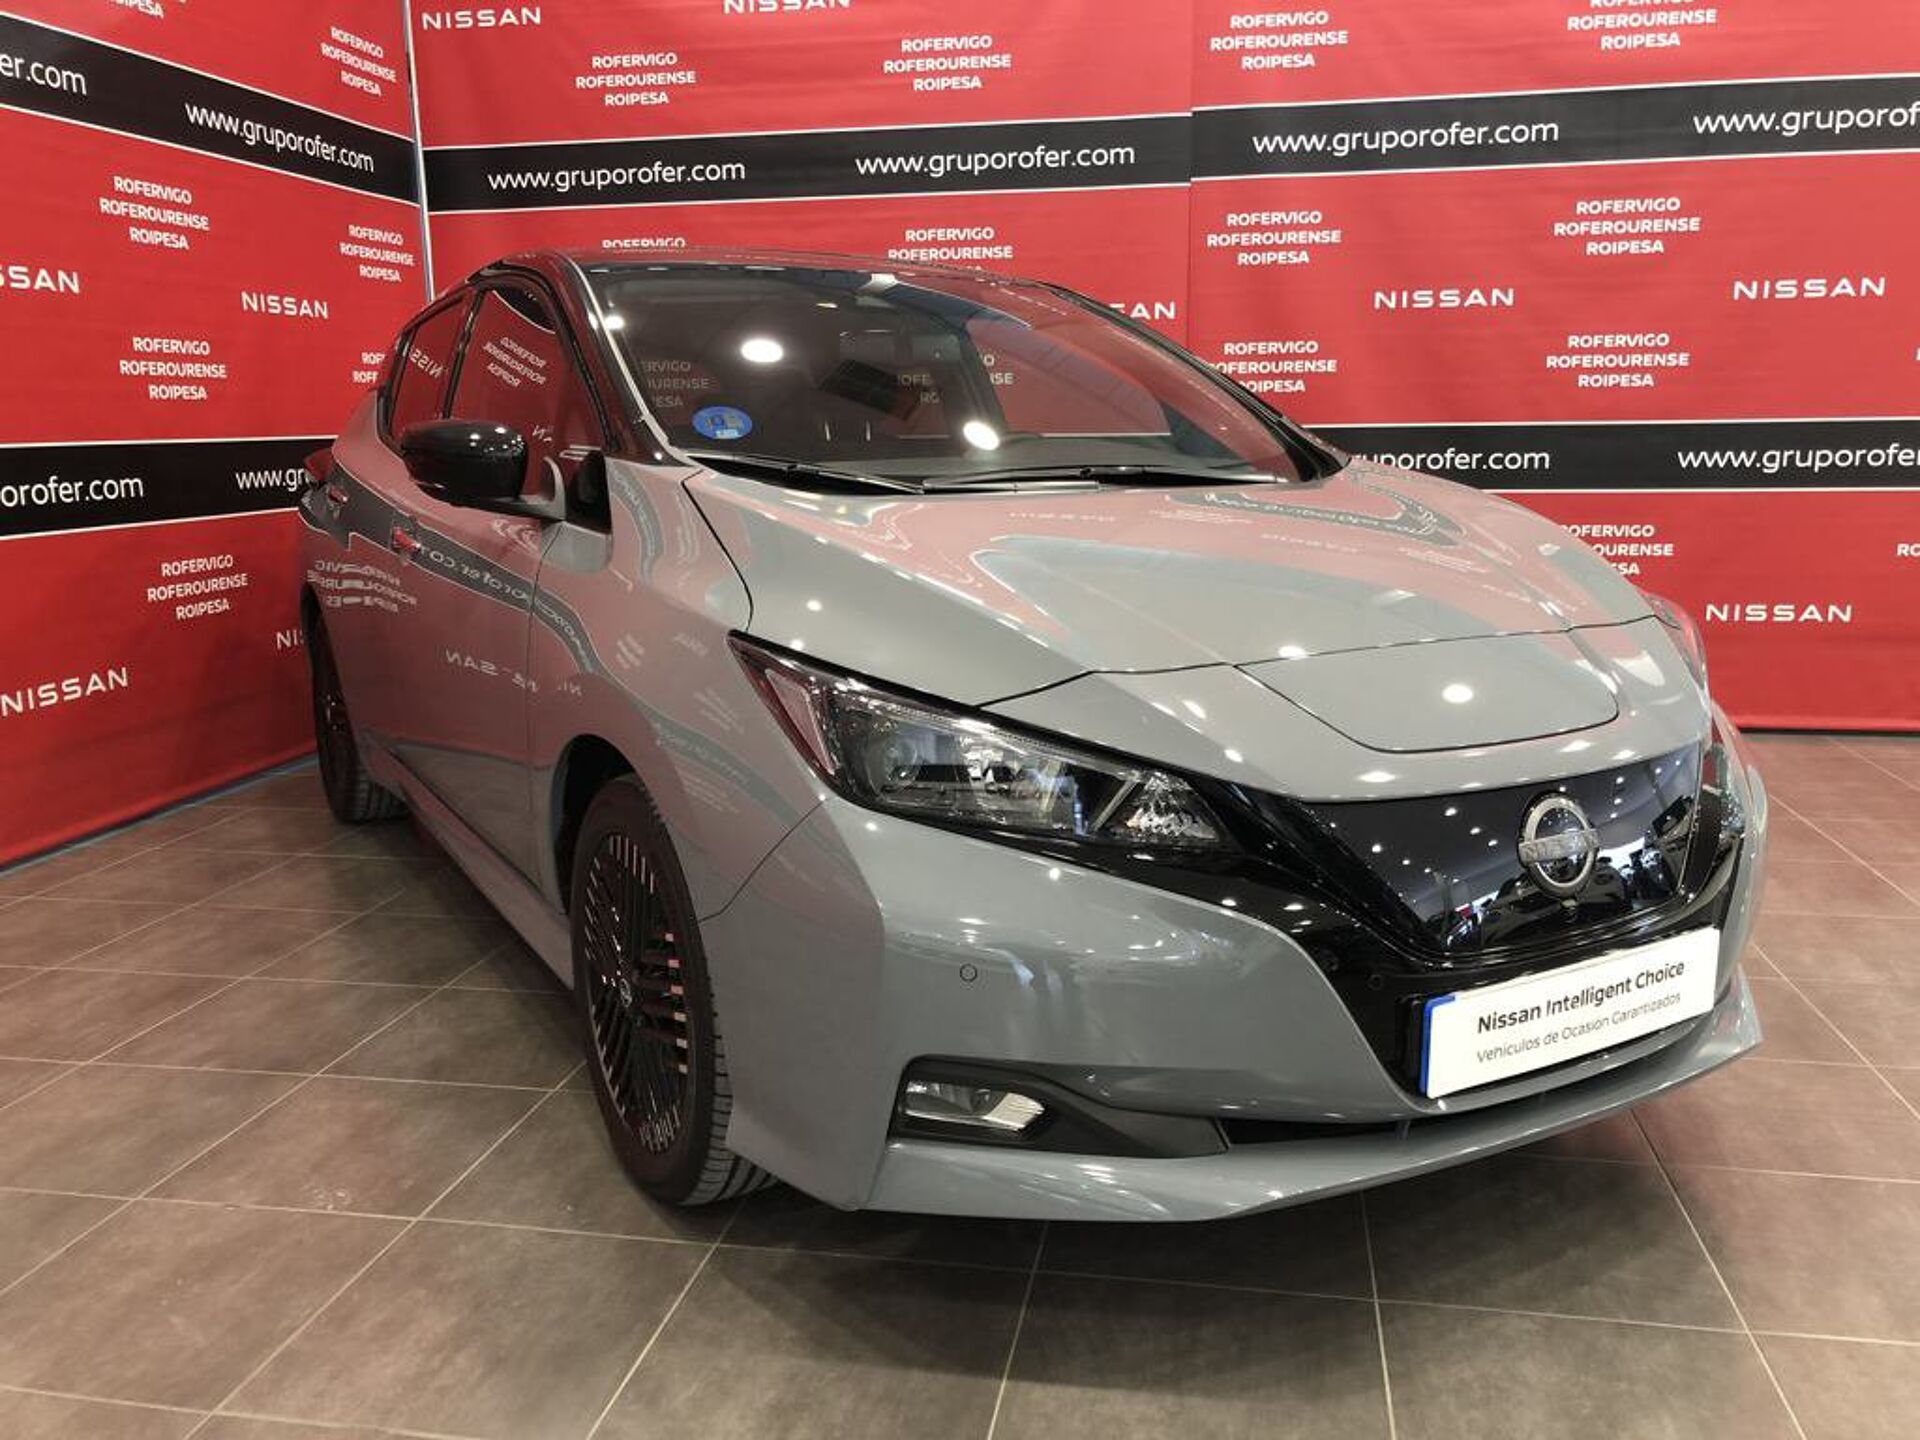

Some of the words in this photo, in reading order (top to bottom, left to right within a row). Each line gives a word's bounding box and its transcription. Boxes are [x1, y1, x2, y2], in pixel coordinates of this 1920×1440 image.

[422, 7, 540, 29] NISSAN
[1231, 11, 1328, 28] ROFERVIGO
[1568, 9, 1716, 30] ROFEROURENSE
[331, 27, 383, 58] ROFERVIGO
[902, 35, 992, 52] ROFERVIGO
[1211, 31, 1348, 50] ROFEROURENSE
[1601, 32, 1680, 49] ROIPESA
[321, 43, 396, 82] ROFEROURENSE
[592, 53, 677, 68] ROFERVIGO
[884, 54, 1011, 73] ROFEROURENSE
[1242, 53, 1315, 69] ROIPESA
[341, 71, 381, 96] ROIPESA
[576, 71, 696, 88] ROFEROURENSE
[914, 76, 981, 90] ROIPESA
[605, 92, 669, 105] ROIPESA
[185, 104, 373, 172] www.gruporofer.com
[1253, 122, 1558, 156] www.gruporofer.com
[856, 145, 1134, 177] www.gruporofer.com
[488, 161, 745, 192] www.gruporofer.com
[114, 176, 192, 204] ROFERVIGO
[100, 198, 209, 230] ROFEROURENSE
[1577, 197, 1680, 214] ROFERVIGO
[1227, 211, 1322, 226] ROFERVIGO
[1554, 217, 1700, 235] ROFEROURENSE
[129, 227, 189, 249] ROIPESA
[349, 225, 403, 245] ROFERVIGO
[906, 227, 994, 241] ROFERVIGO
[1207, 230, 1341, 246] ROFEROURENSE
[340, 243, 414, 266] ROFEROURENSE
[888, 246, 1012, 261] ROFEROURENSE
[1586, 240, 1664, 255] ROIPESA
[1238, 251, 1309, 265] ROIPESA
[0, 265, 80, 293] SAN
[360, 265, 401, 281] ROIPESA
[1734, 278, 1885, 300] NISSAN
[242, 292, 328, 318] NISSAN
[1375, 289, 1514, 308] NISSAN
[133, 337, 210, 355] ROFERVIGO
[1224, 341, 1318, 355] ROFERVIGO
[1568, 334, 1669, 347] ROFERVIGO
[120, 360, 226, 378] ROFEROURENSE
[1208, 360, 1337, 374] OFEROURENSE
[1547, 353, 1689, 368] ROFEROURENSE
[1578, 374, 1654, 387] ROIPESA
[149, 385, 207, 399] ROIPESA
[1676, 443, 1920, 473] www.gruporofe
[161, 555, 233, 576] ROFERVIGO
[147, 574, 247, 601] ROFEROURENSE
[176, 598, 229, 619] ROIPESA
[1706, 604, 1851, 622] NISSAN
[0, 667, 128, 716] NISSAN
[1478, 1005, 1541, 1033] Nissan
[1546, 978, 1632, 1017] Intelligent
[1635, 961, 1685, 988] Choice
[1543, 1031, 1559, 1046] de
